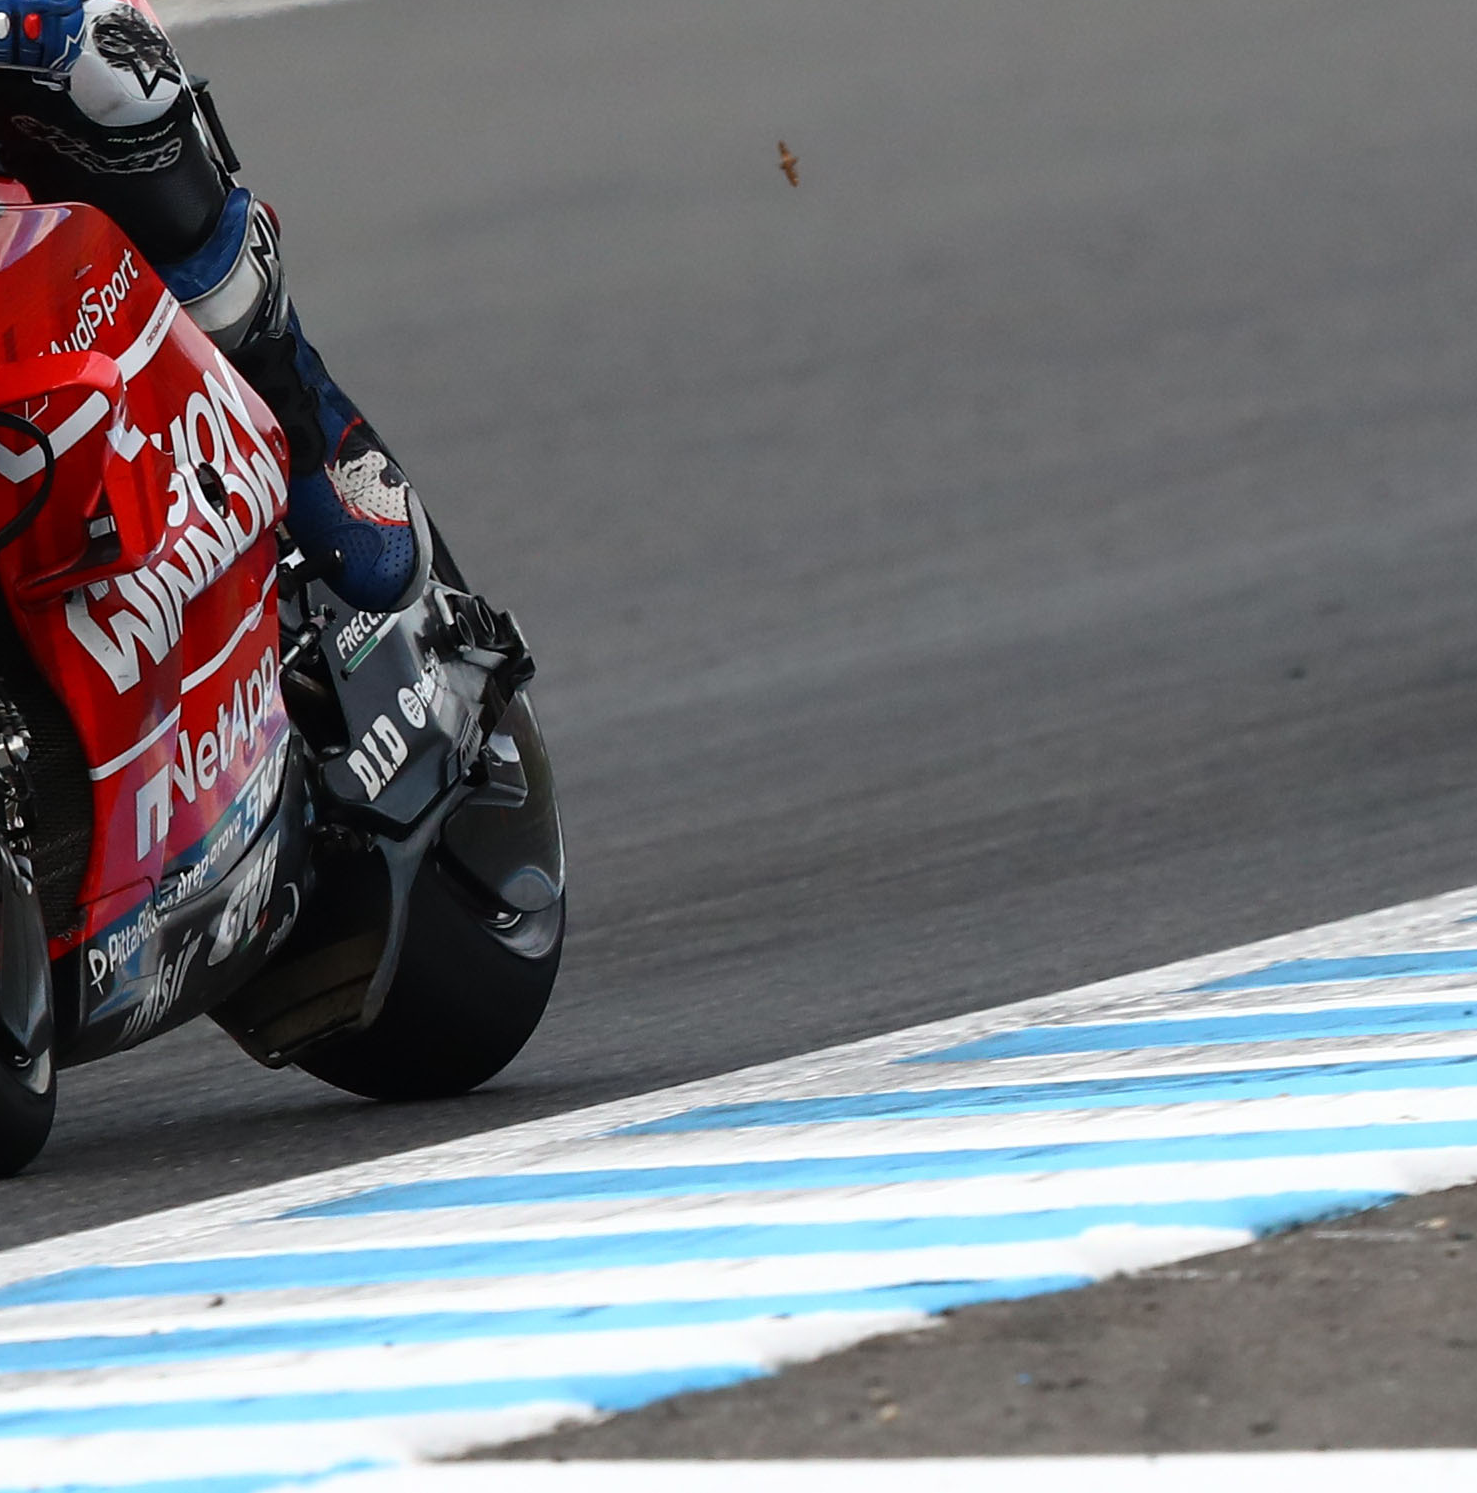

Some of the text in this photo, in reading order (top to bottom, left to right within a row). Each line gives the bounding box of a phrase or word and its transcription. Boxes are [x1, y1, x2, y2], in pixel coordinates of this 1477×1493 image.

[81, 248, 140, 327] Sport
[335, 610, 386, 660] FRECC
[173, 645, 276, 805] NetApp
[346, 714, 409, 802] D.I.D
